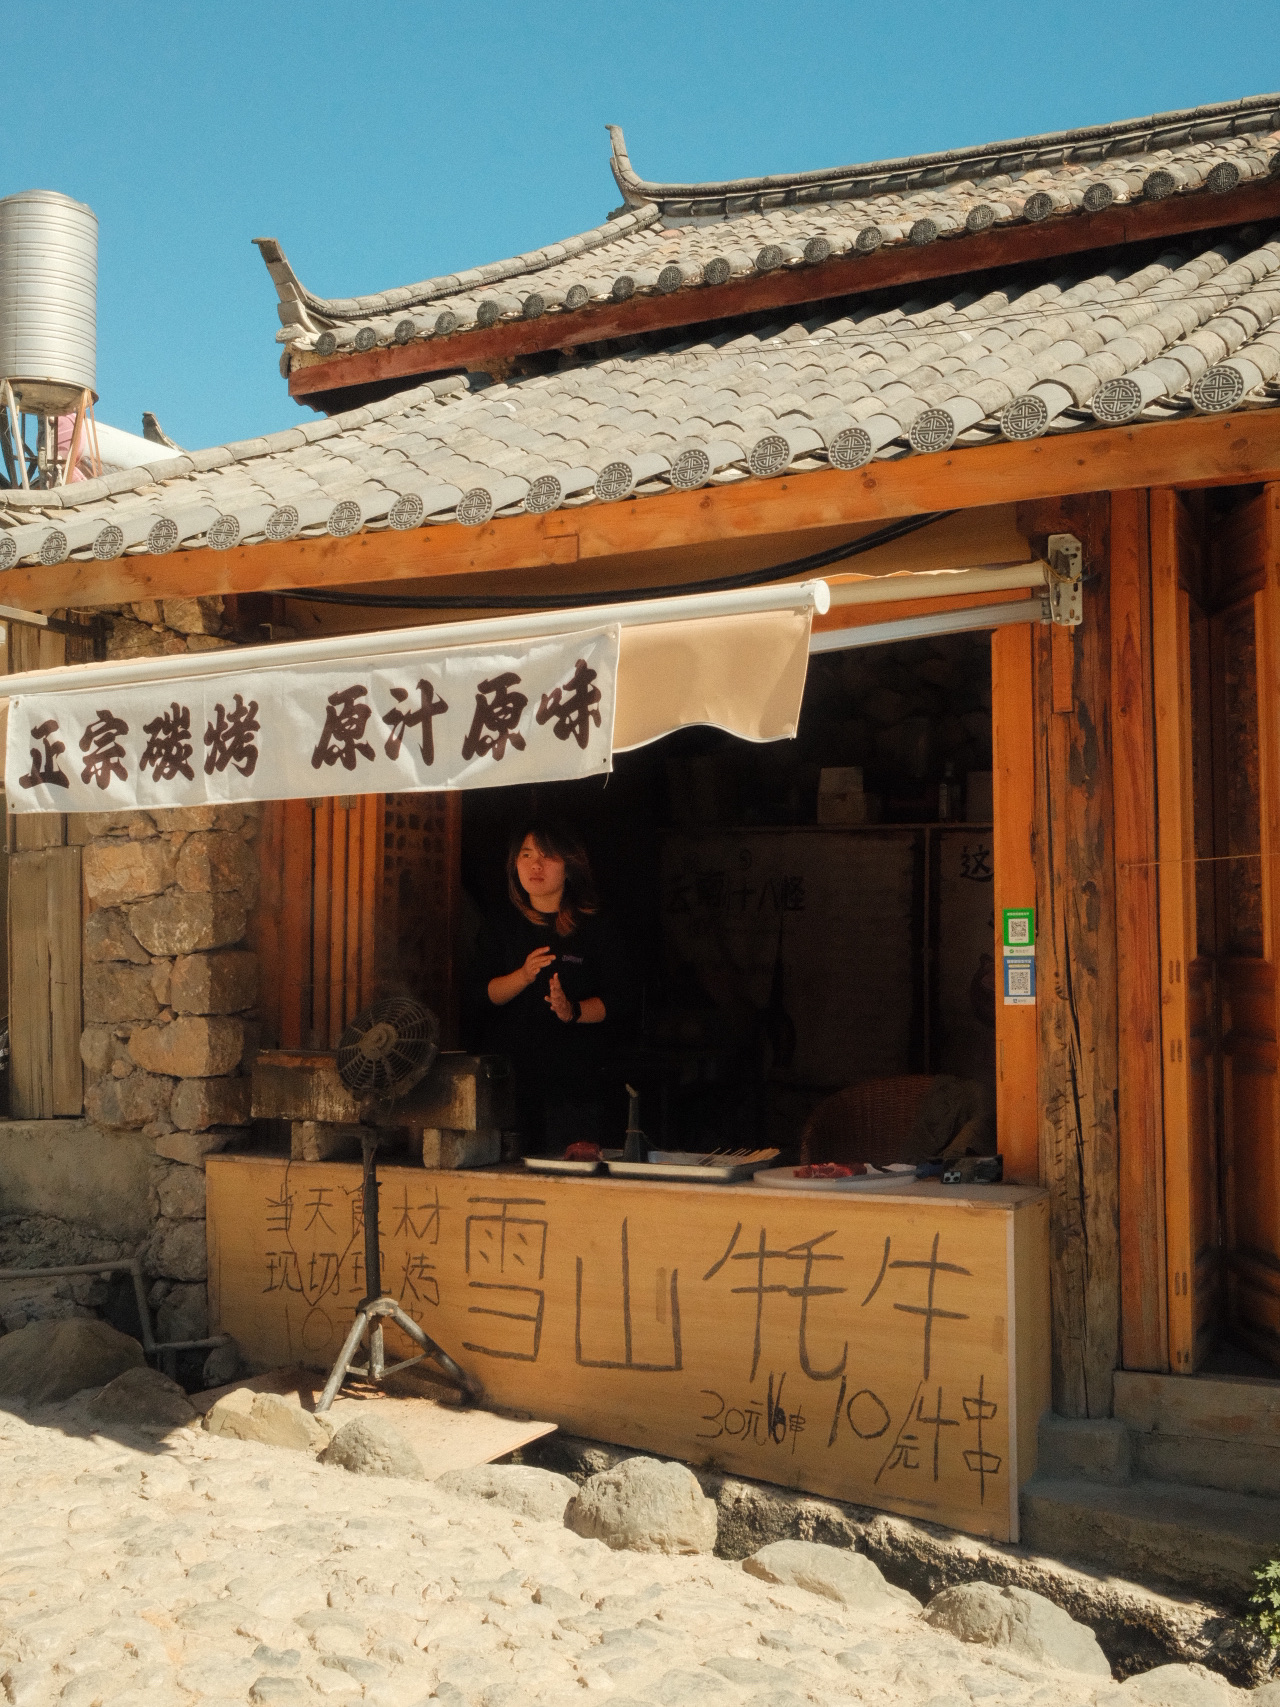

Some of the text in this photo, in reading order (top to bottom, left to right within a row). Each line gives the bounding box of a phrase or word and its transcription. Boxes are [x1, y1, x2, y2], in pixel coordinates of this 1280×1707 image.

[18, 658, 604, 791] 正宗碳烤 原汁原味
[461, 1196, 974, 1383] 雪山牦牛
